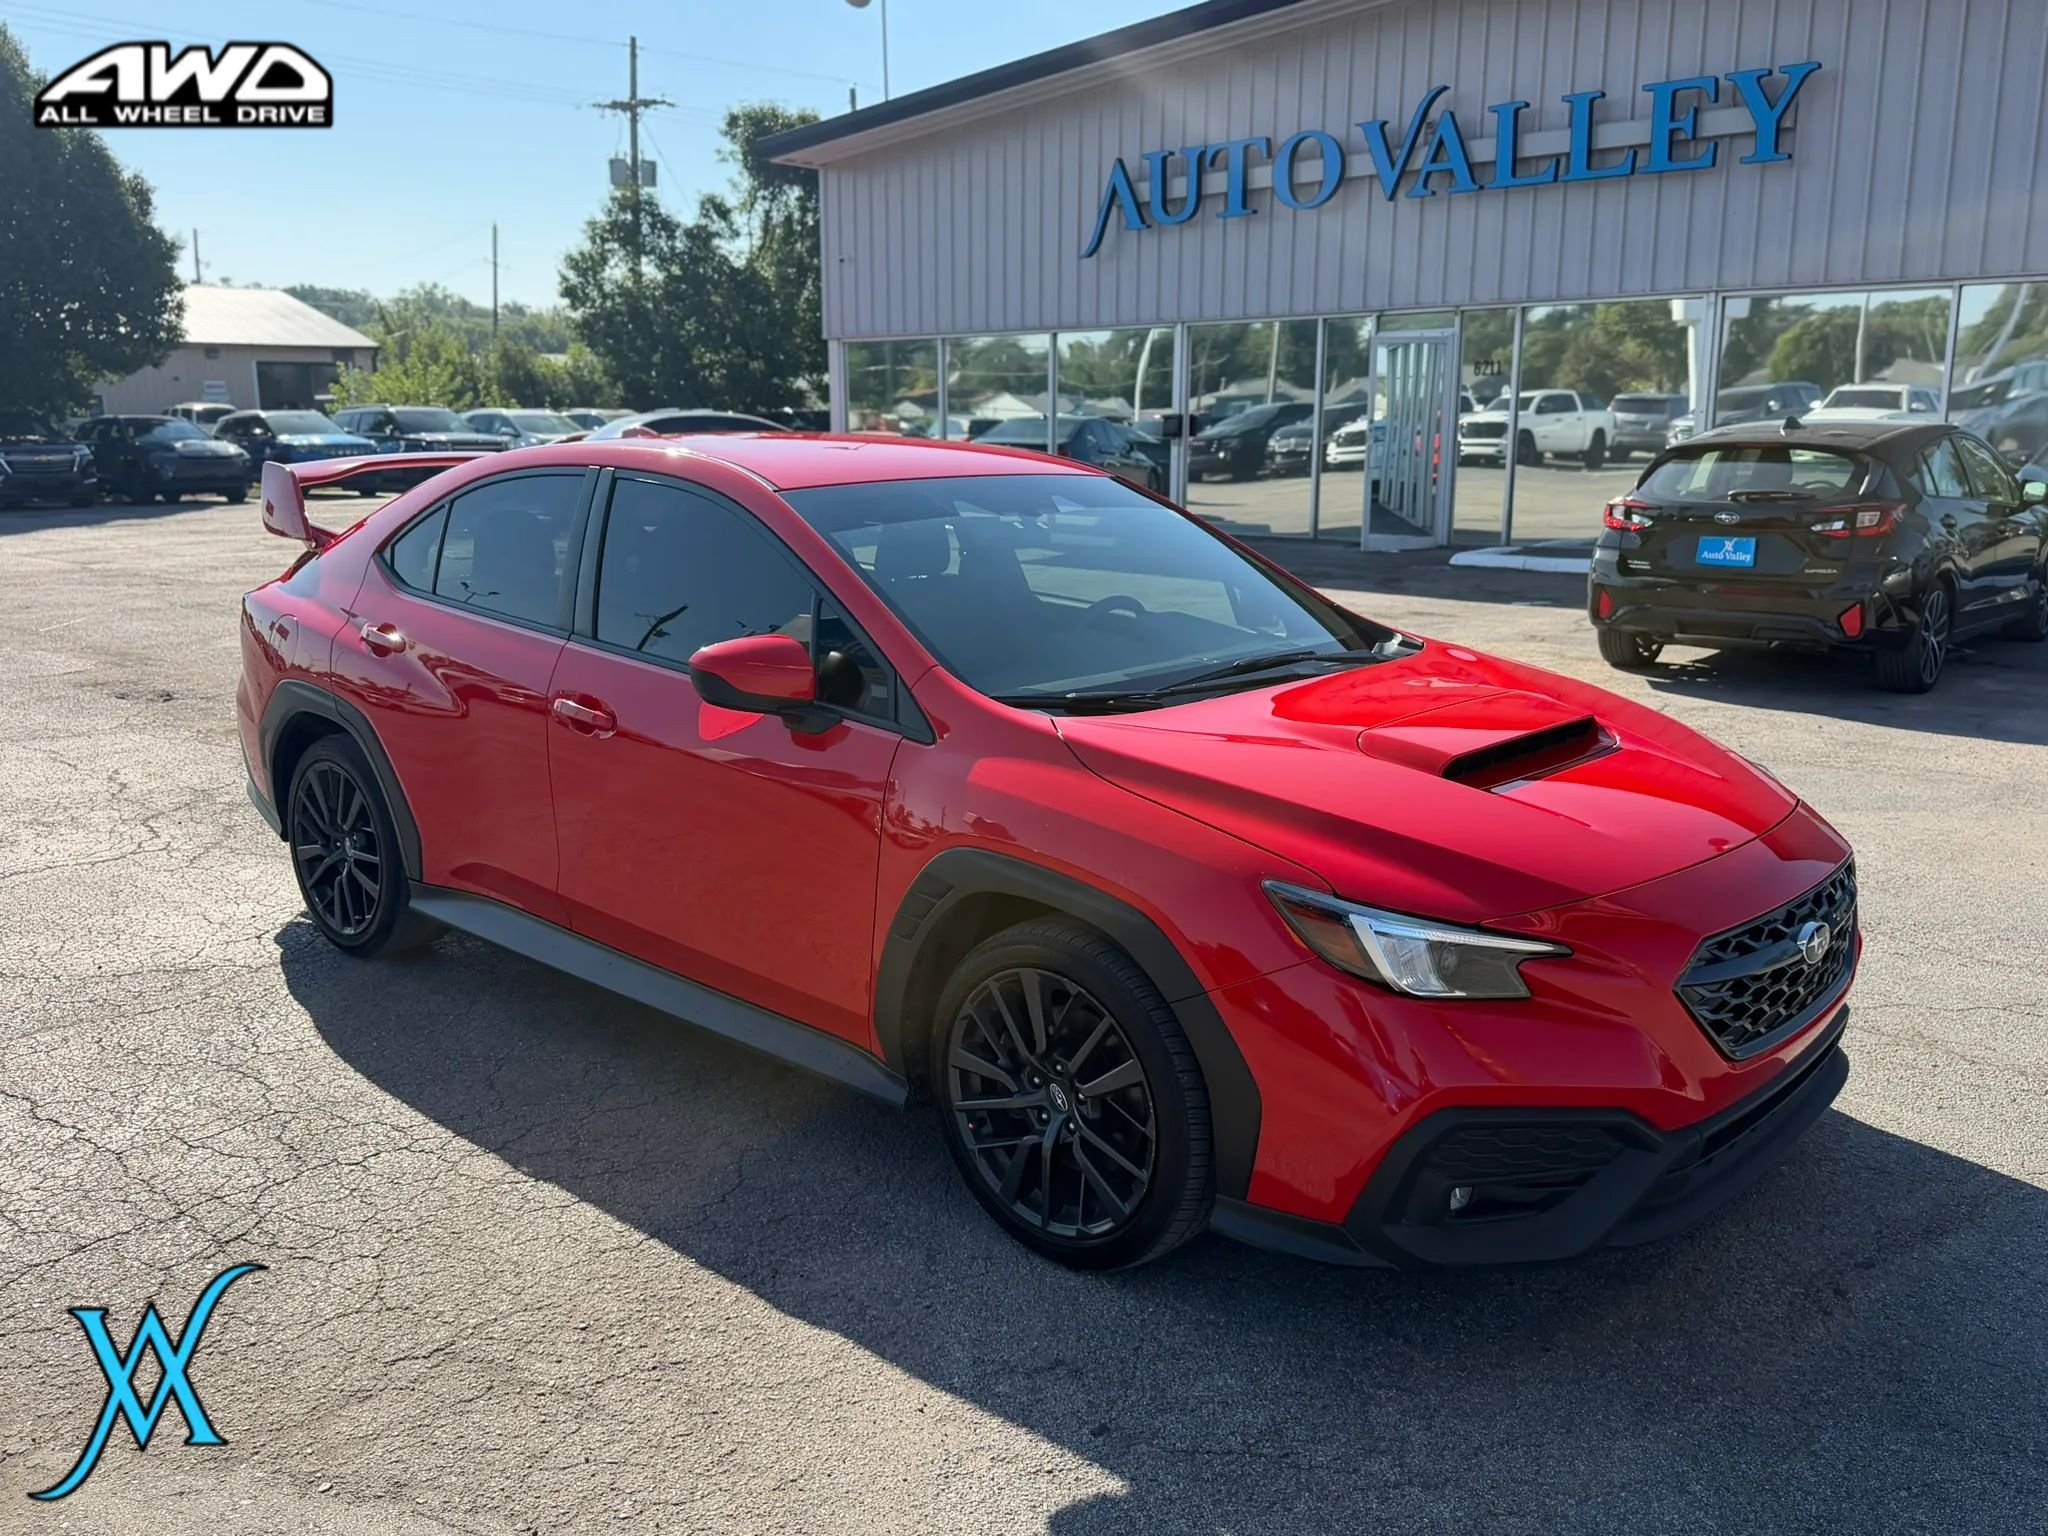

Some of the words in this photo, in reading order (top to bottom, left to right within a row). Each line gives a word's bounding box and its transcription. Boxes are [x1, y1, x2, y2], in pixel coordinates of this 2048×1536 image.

[1079, 128, 1346, 259] AUTO
[1354, 61, 1823, 201] VALLEY
[1474, 359, 1503, 377] 6211
[1701, 550, 1725, 561] Auto
[1725, 551, 1752, 563] Valley
